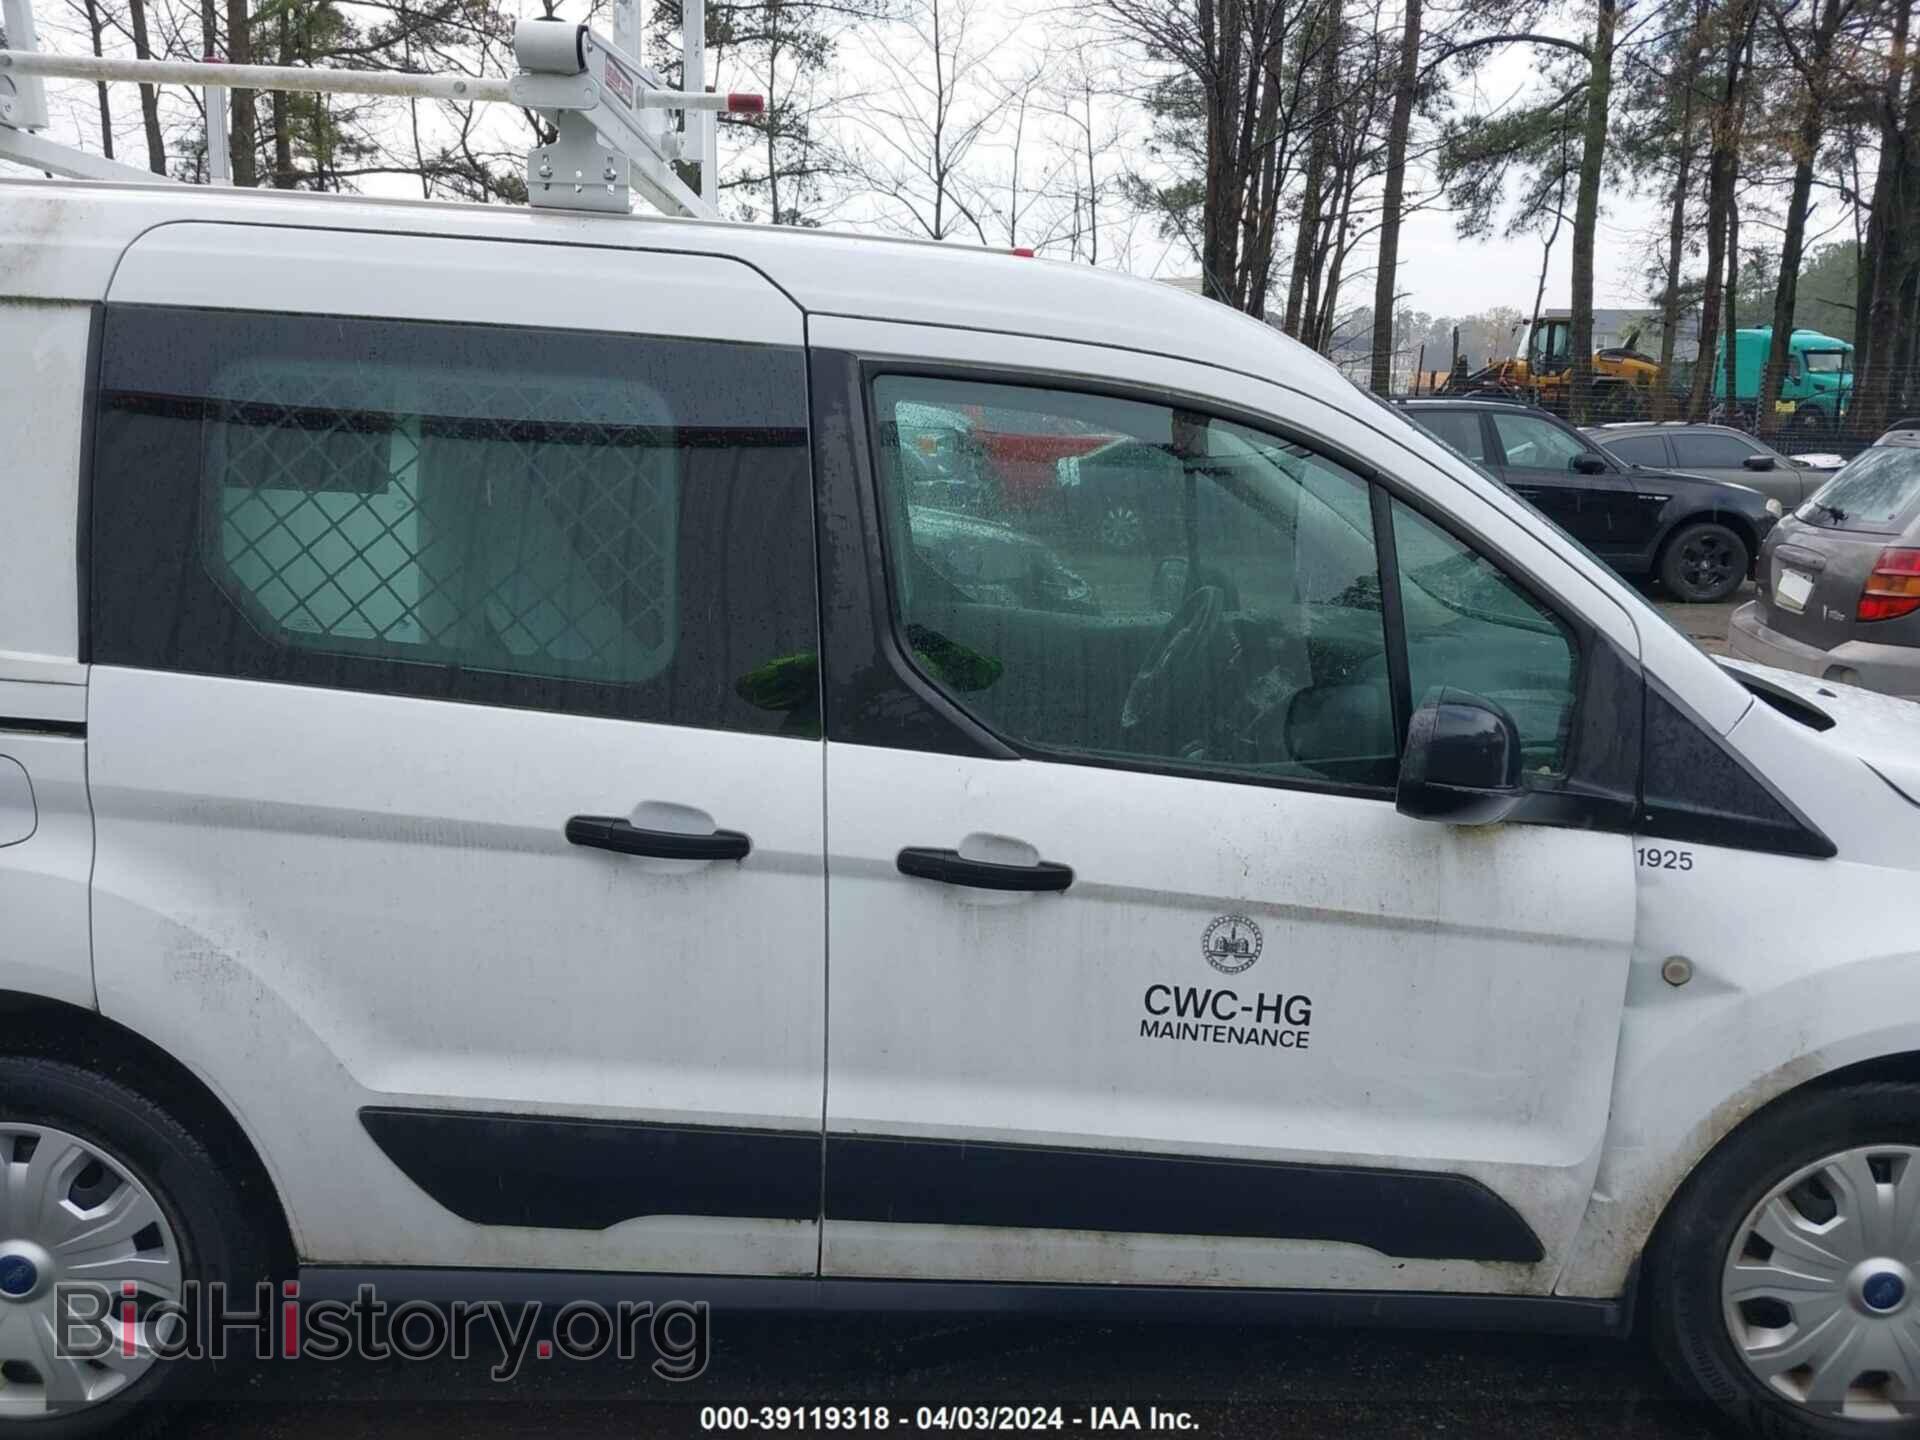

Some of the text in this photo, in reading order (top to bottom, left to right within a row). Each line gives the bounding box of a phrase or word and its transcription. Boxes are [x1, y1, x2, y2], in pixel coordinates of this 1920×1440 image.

[1637, 847, 1694, 871] 1925
[1144, 984, 1312, 1026] CWC-HG
[1139, 1019, 1310, 1049] MAINTENANCE
